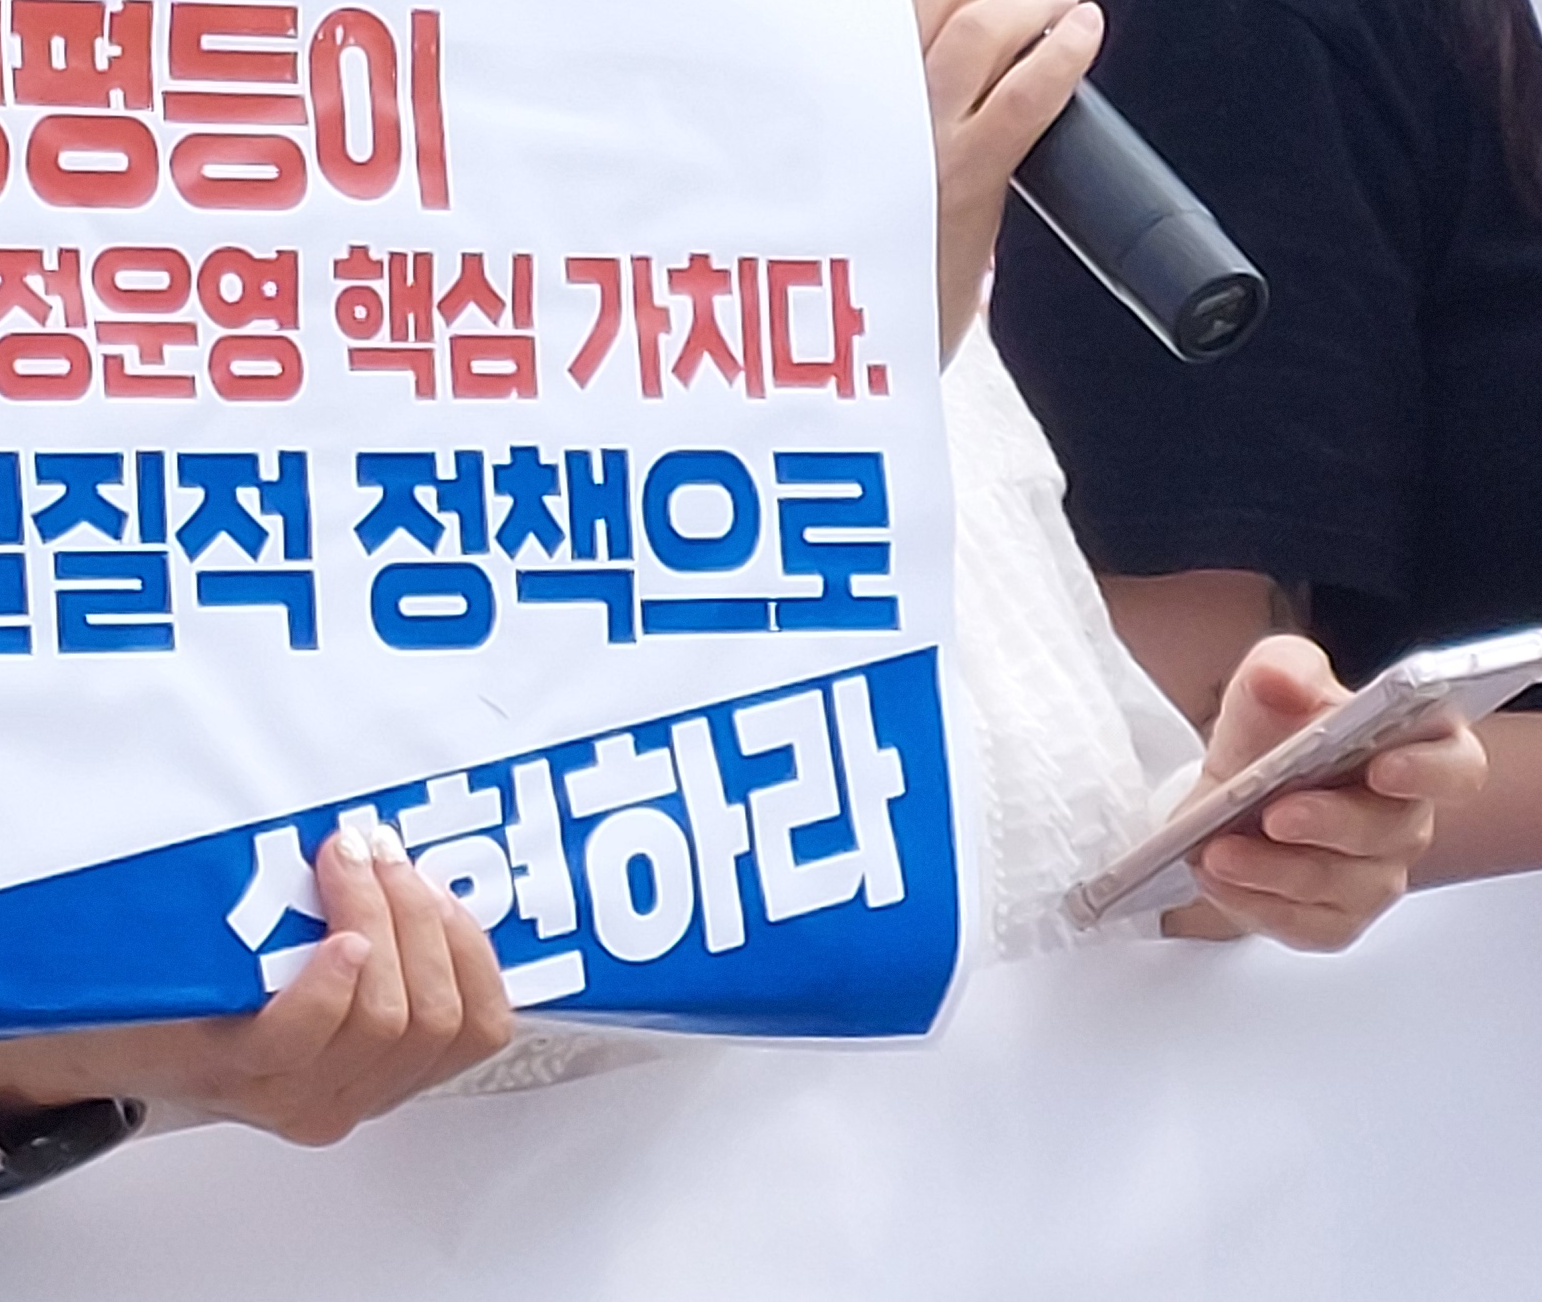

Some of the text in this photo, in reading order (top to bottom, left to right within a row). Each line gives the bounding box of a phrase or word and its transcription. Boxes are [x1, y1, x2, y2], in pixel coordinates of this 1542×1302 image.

[332, 244, 537, 400] 핵심
[565, 253, 890, 398] 가치다.
[352, 444, 901, 652] 정책으로
